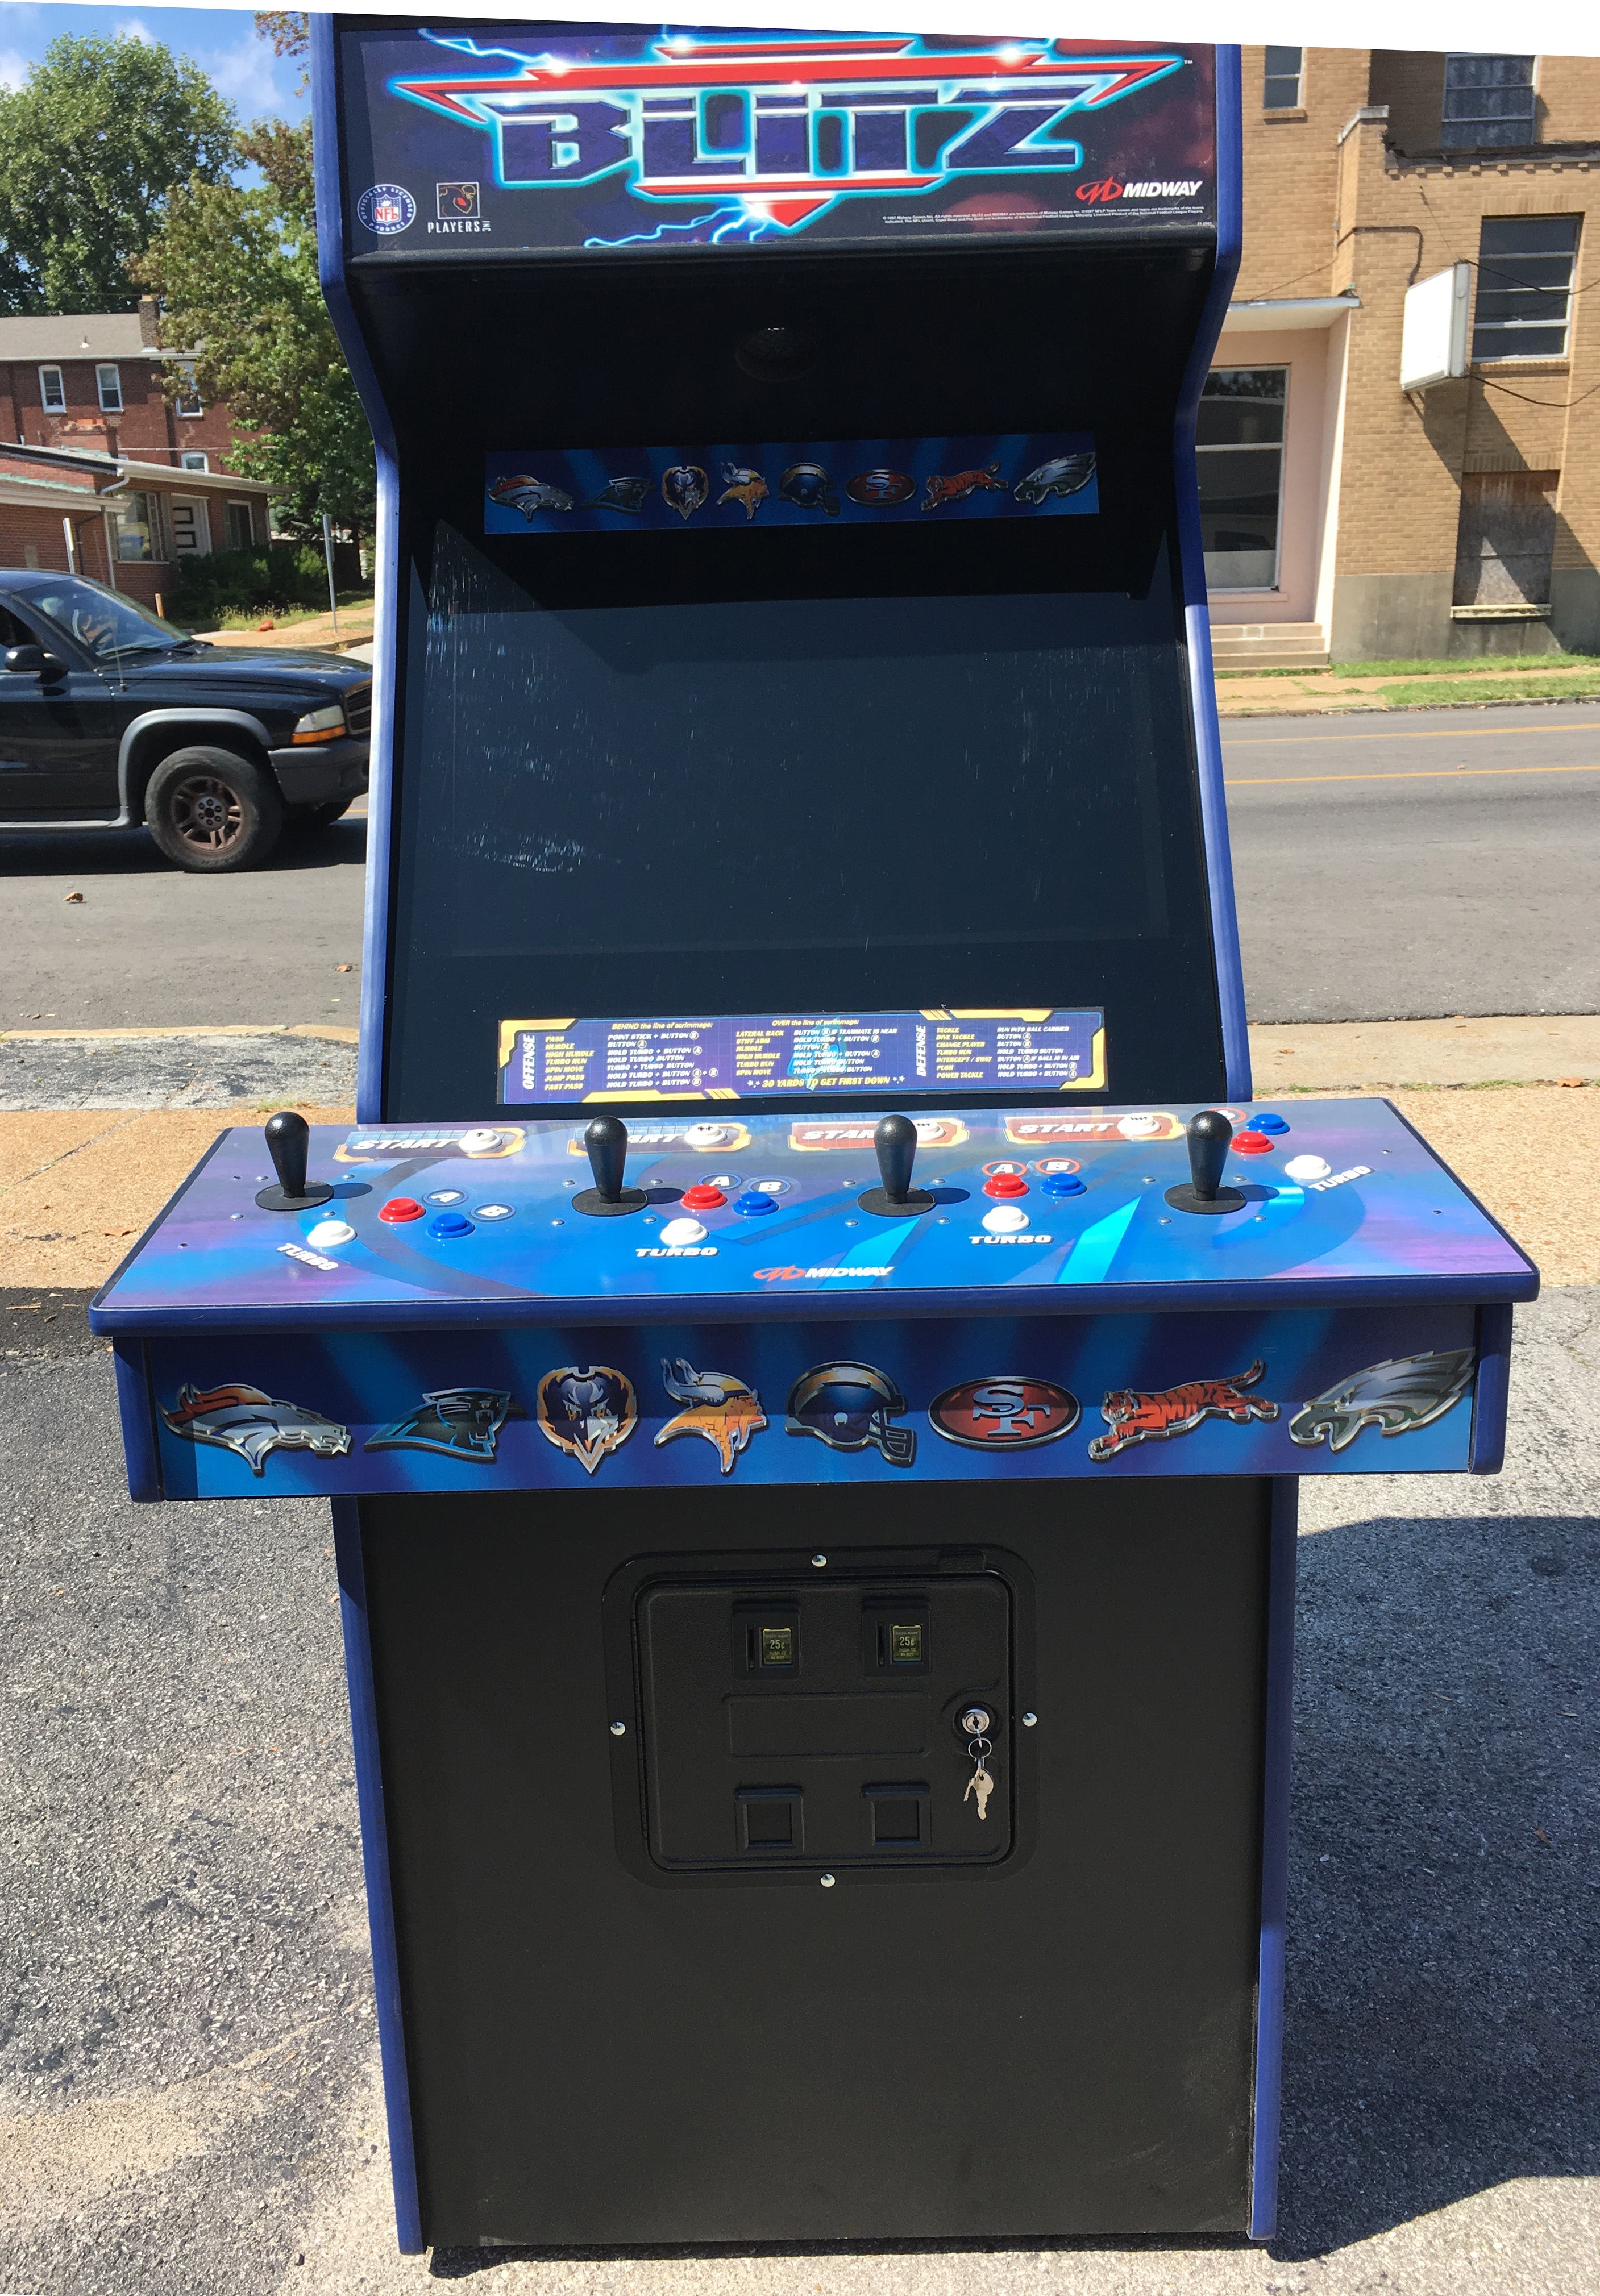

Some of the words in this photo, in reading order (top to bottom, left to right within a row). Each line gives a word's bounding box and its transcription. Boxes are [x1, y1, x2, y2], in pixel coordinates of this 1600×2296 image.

[481, 85, 1095, 181] BLITZ
[1123, 181, 1203, 198] MIDWAY
[362, 187, 387, 220] OFFICIALLY
[391, 188, 413, 218] LICENSED
[375, 207, 399, 222] NFL
[369, 221, 405, 232] PRODUCT
[427, 221, 480, 234] PLAYERS
[482, 220, 491, 232] INC
[916, 1025, 926, 1077] DEFENSE
[522, 1034, 535, 1090] OFFENSE
[1018, 1122, 1114, 1134] START
[802, 1129, 875, 1141] STAR
[352, 1138, 458, 1150] START
[992, 1163, 1014, 1174] A
[1045, 1161, 1070, 1172] B
[709, 1176, 731, 1187] A
[1308, 1165, 1375, 1192] TURBO
[757, 1181, 782, 1192] B
[430, 1191, 460, 1203] A
[477, 1205, 509, 1217] B
[969, 1234, 1054, 1245] TURBO
[276, 1242, 339, 1271] TURBO
[635, 1246, 720, 1258] TURBO
[805, 1266, 895, 1278] MIDWAY
[973, 1384, 1051, 1438] SF
[770, 1639, 786, 1650] 25¢
[899, 1636, 915, 1647] 25¢
